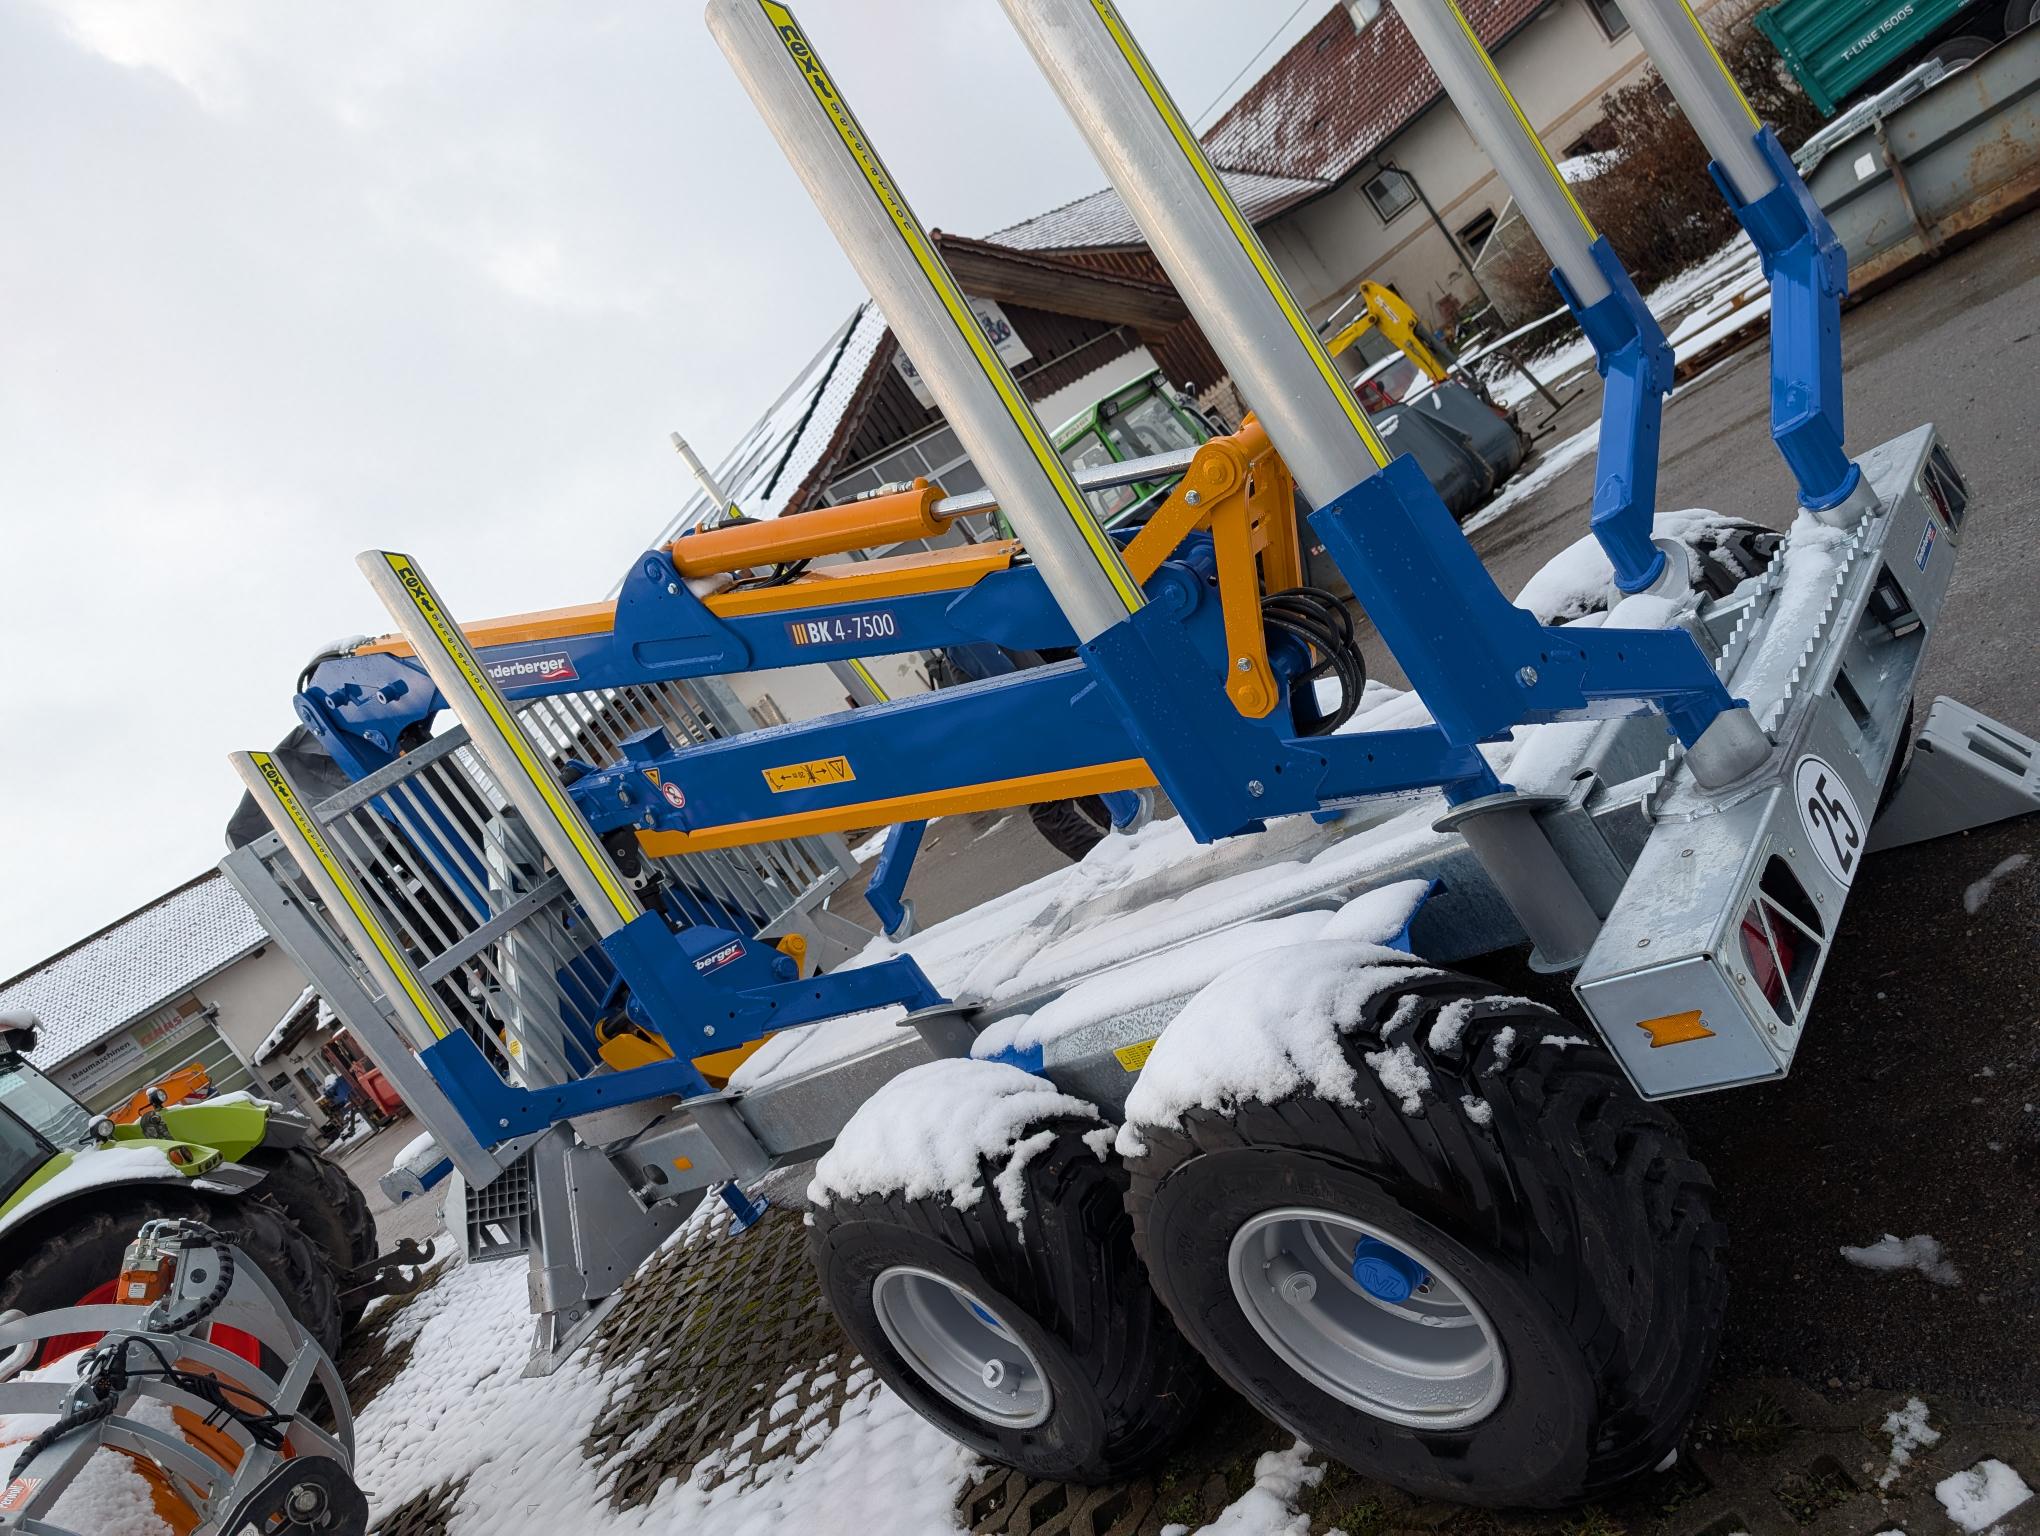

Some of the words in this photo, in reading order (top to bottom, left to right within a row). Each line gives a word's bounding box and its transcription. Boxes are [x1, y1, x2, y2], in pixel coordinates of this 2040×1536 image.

[1840, 30, 1880, 61] T-LINE
[1879, 4, 1914, 34] 1500S
[778, 25, 833, 99] next
[829, 101, 912, 232] generation
[398, 567, 434, 612] next
[807, 621, 833, 644] BK
[260, 762, 289, 797] next
[1808, 772, 1860, 876] 25
[695, 944, 737, 970] berger
